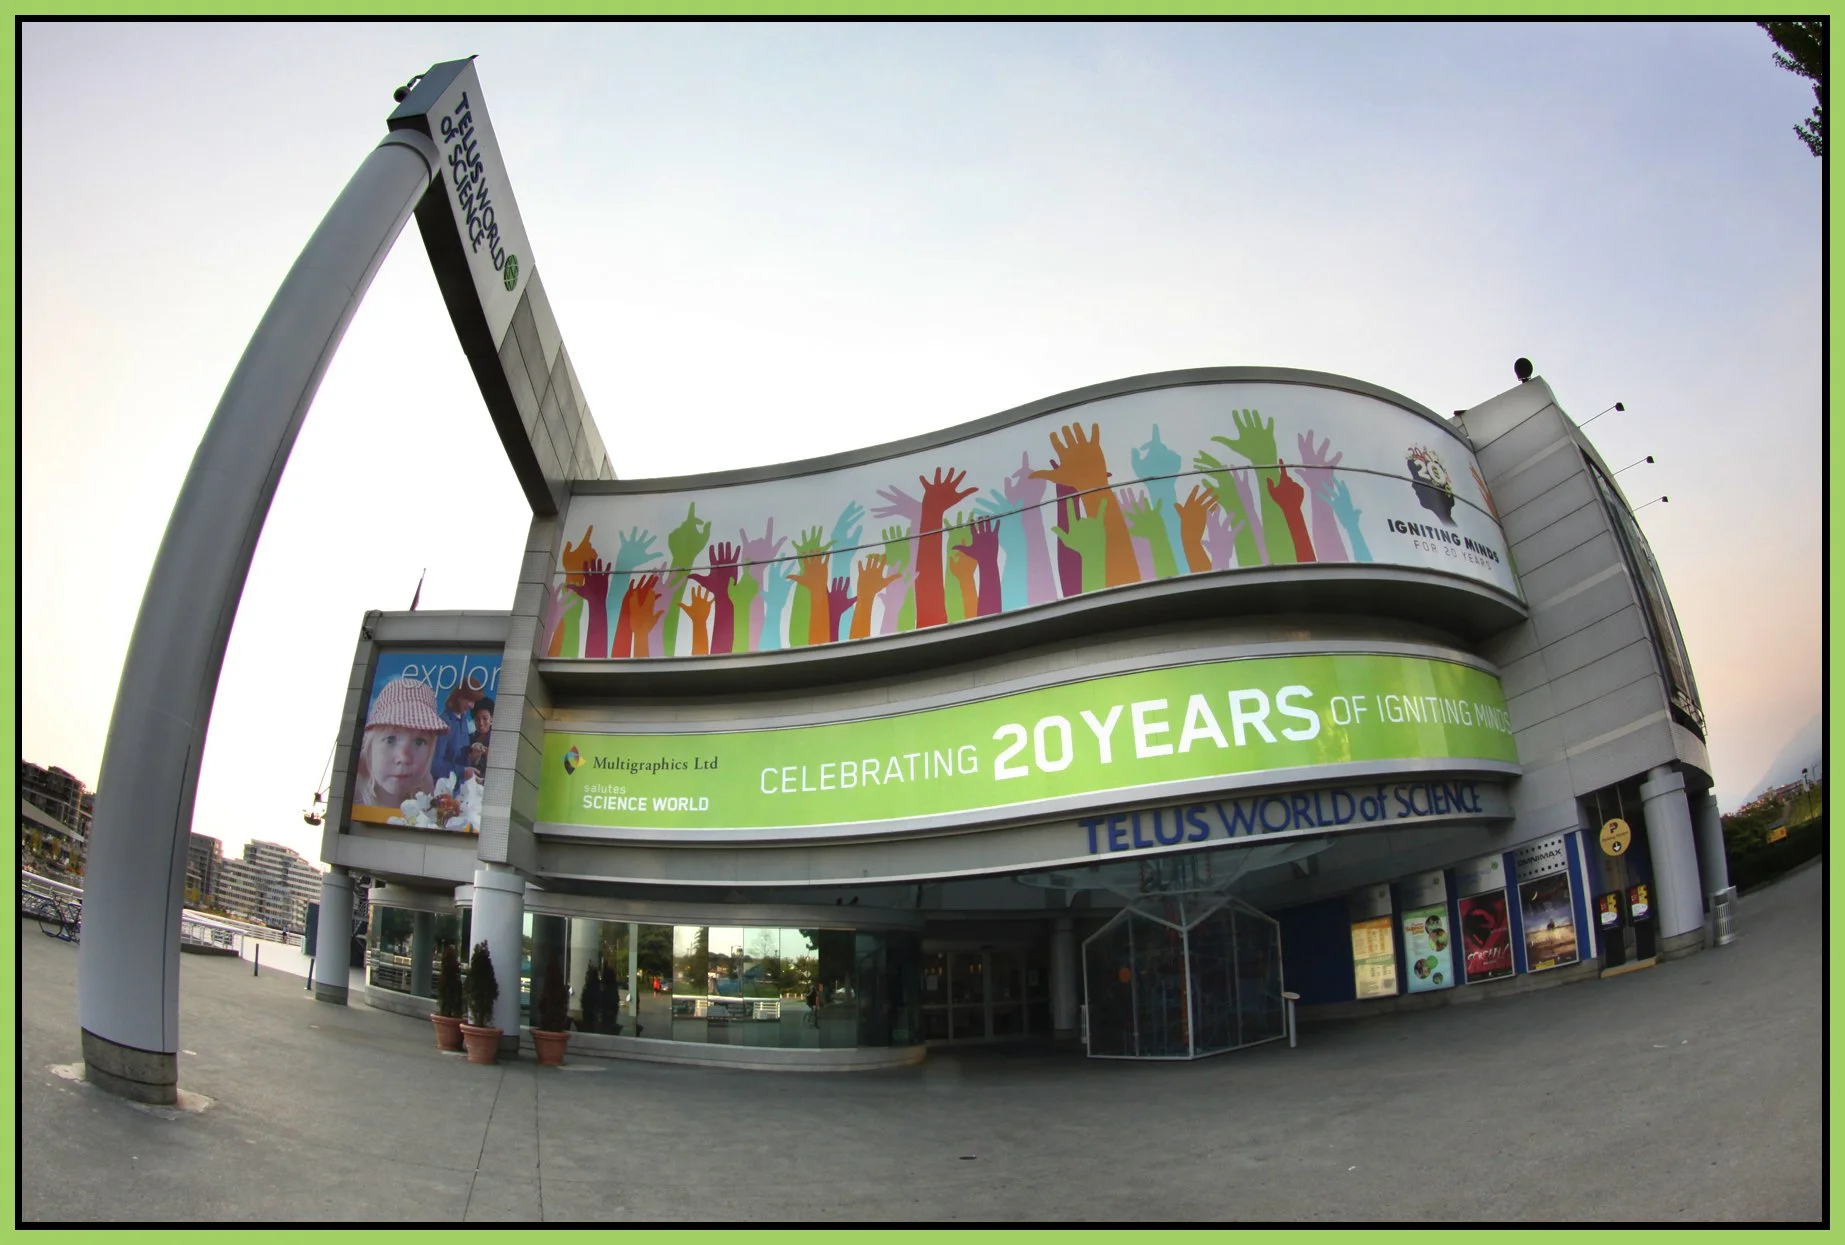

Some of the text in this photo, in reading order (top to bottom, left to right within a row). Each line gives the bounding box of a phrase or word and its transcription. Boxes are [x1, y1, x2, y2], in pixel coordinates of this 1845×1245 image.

[448, 144, 485, 254] SCIENCE
[455, 91, 505, 271] TELUS WORLD
[1387, 519, 1500, 564] IGNITING MINDS
[1413, 540, 1492, 570] FOR 20 YEARS
[760, 685, 1513, 794] CELEBRATING 20 YEARS OF IGNITING MINDS
[593, 756, 718, 775] Multigraphics Ltd
[583, 795, 709, 811] SCIENCE WORLD
[584, 784, 626, 794] salutes
[1078, 780, 1484, 855] TELUS WORLD of SCIENCE
[1517, 848, 1562, 867] OMNIMAX
